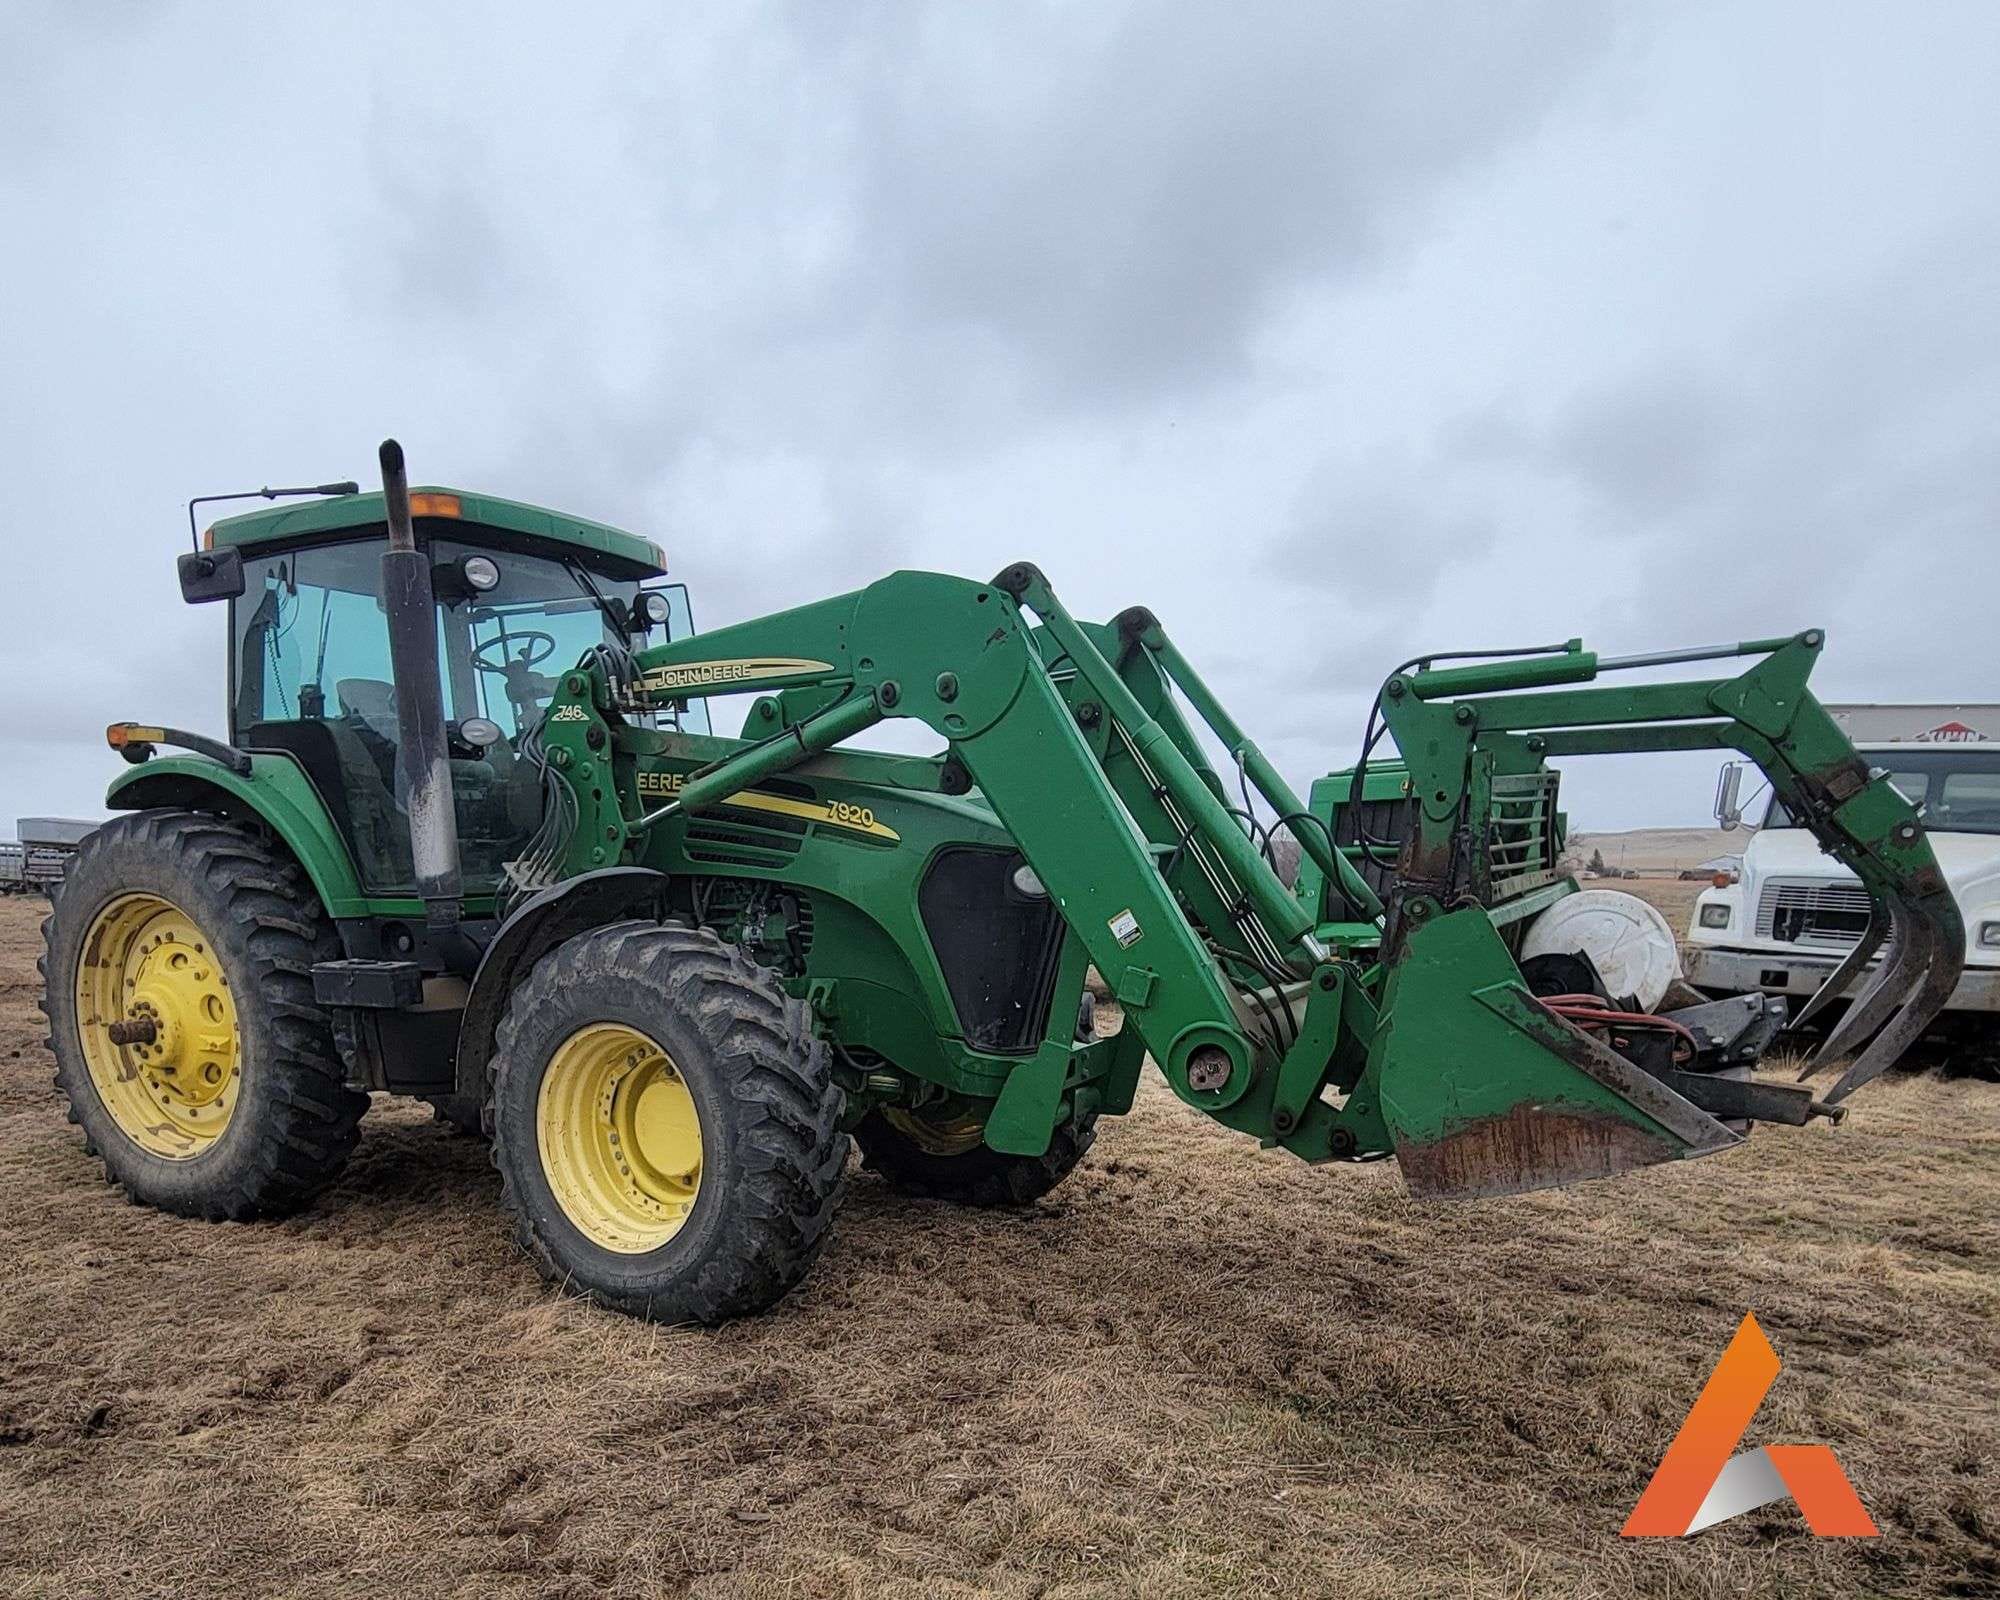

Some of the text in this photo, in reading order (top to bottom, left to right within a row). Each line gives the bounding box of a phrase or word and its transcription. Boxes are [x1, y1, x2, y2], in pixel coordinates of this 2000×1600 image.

[656, 664, 751, 687] JOHN DEERE
[557, 704, 583, 719] 746
[637, 772, 684, 790] EERE
[826, 799, 874, 827] 7920
